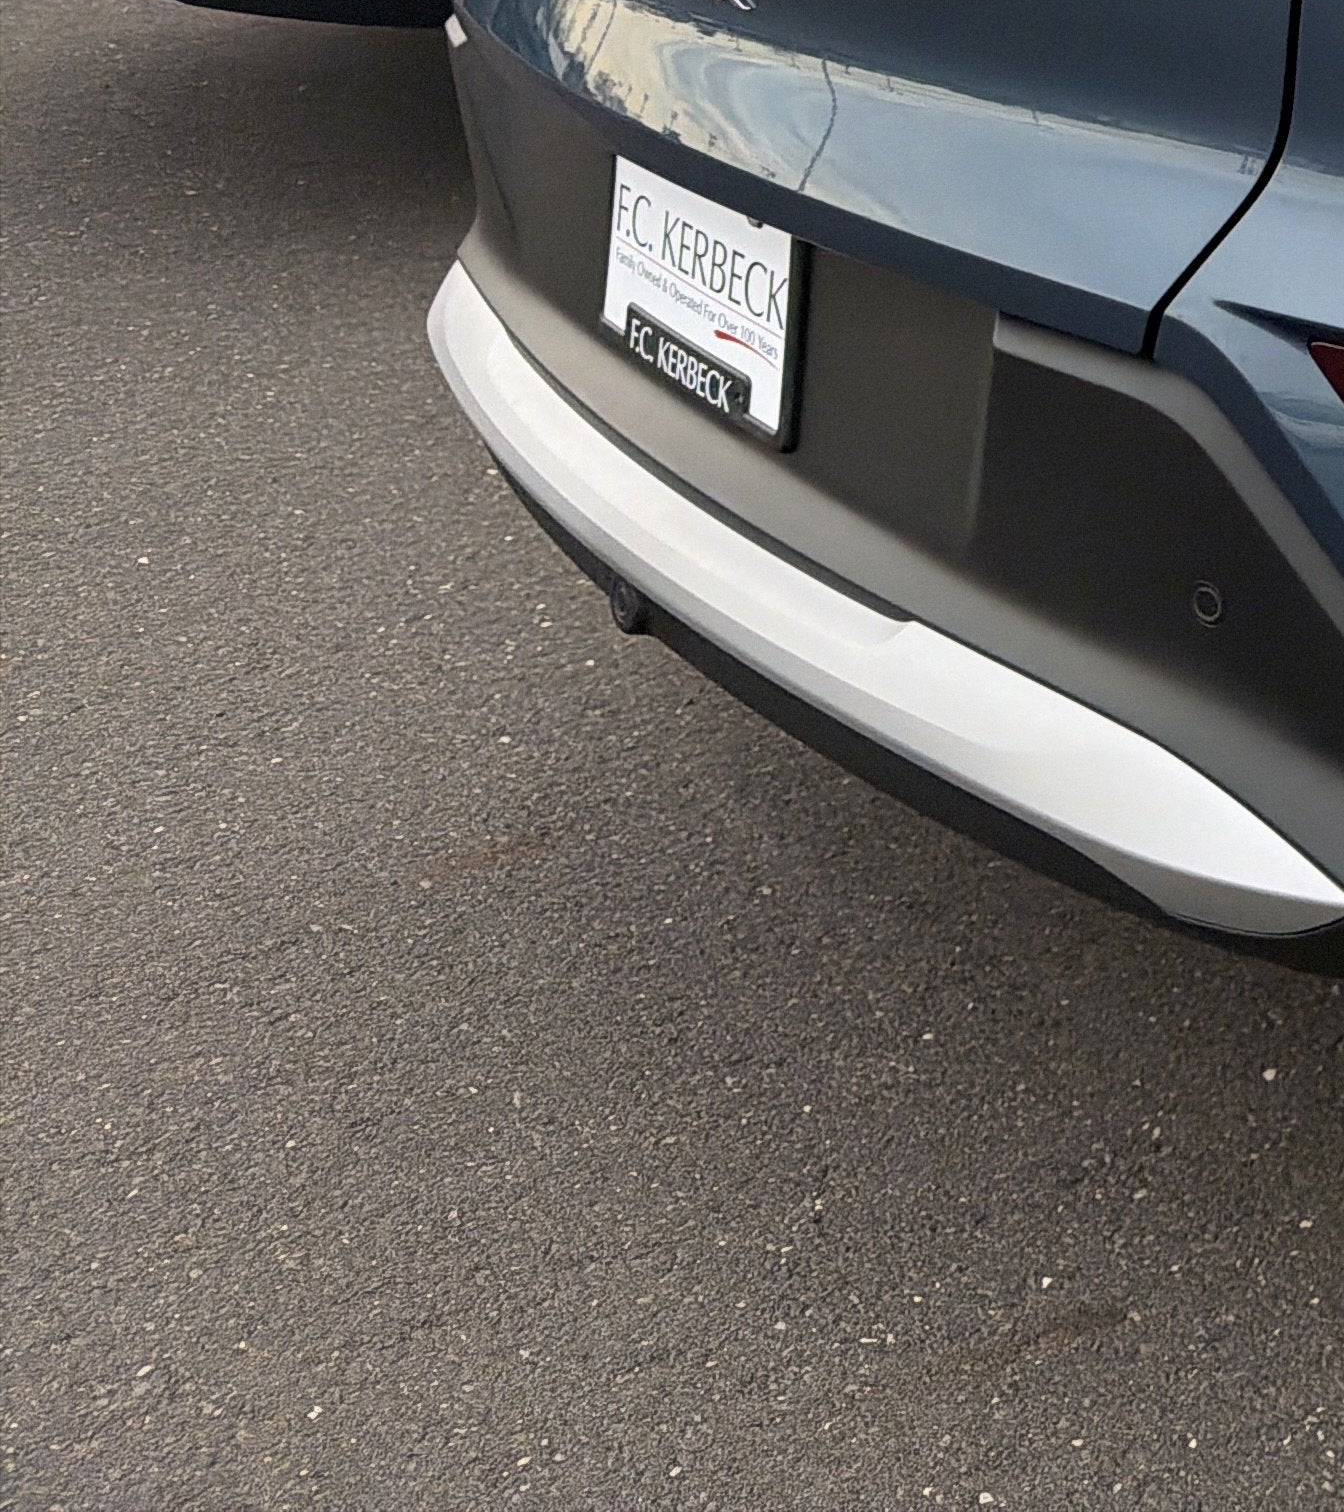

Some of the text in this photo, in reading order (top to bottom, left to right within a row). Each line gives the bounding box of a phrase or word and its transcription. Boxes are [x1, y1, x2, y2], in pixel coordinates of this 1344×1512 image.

[616, 183, 788, 330] F.C. KERBECK
[616, 246, 779, 360] Family Owned & Operated For Over 100 Years
[657, 336, 732, 413] KERBECK
